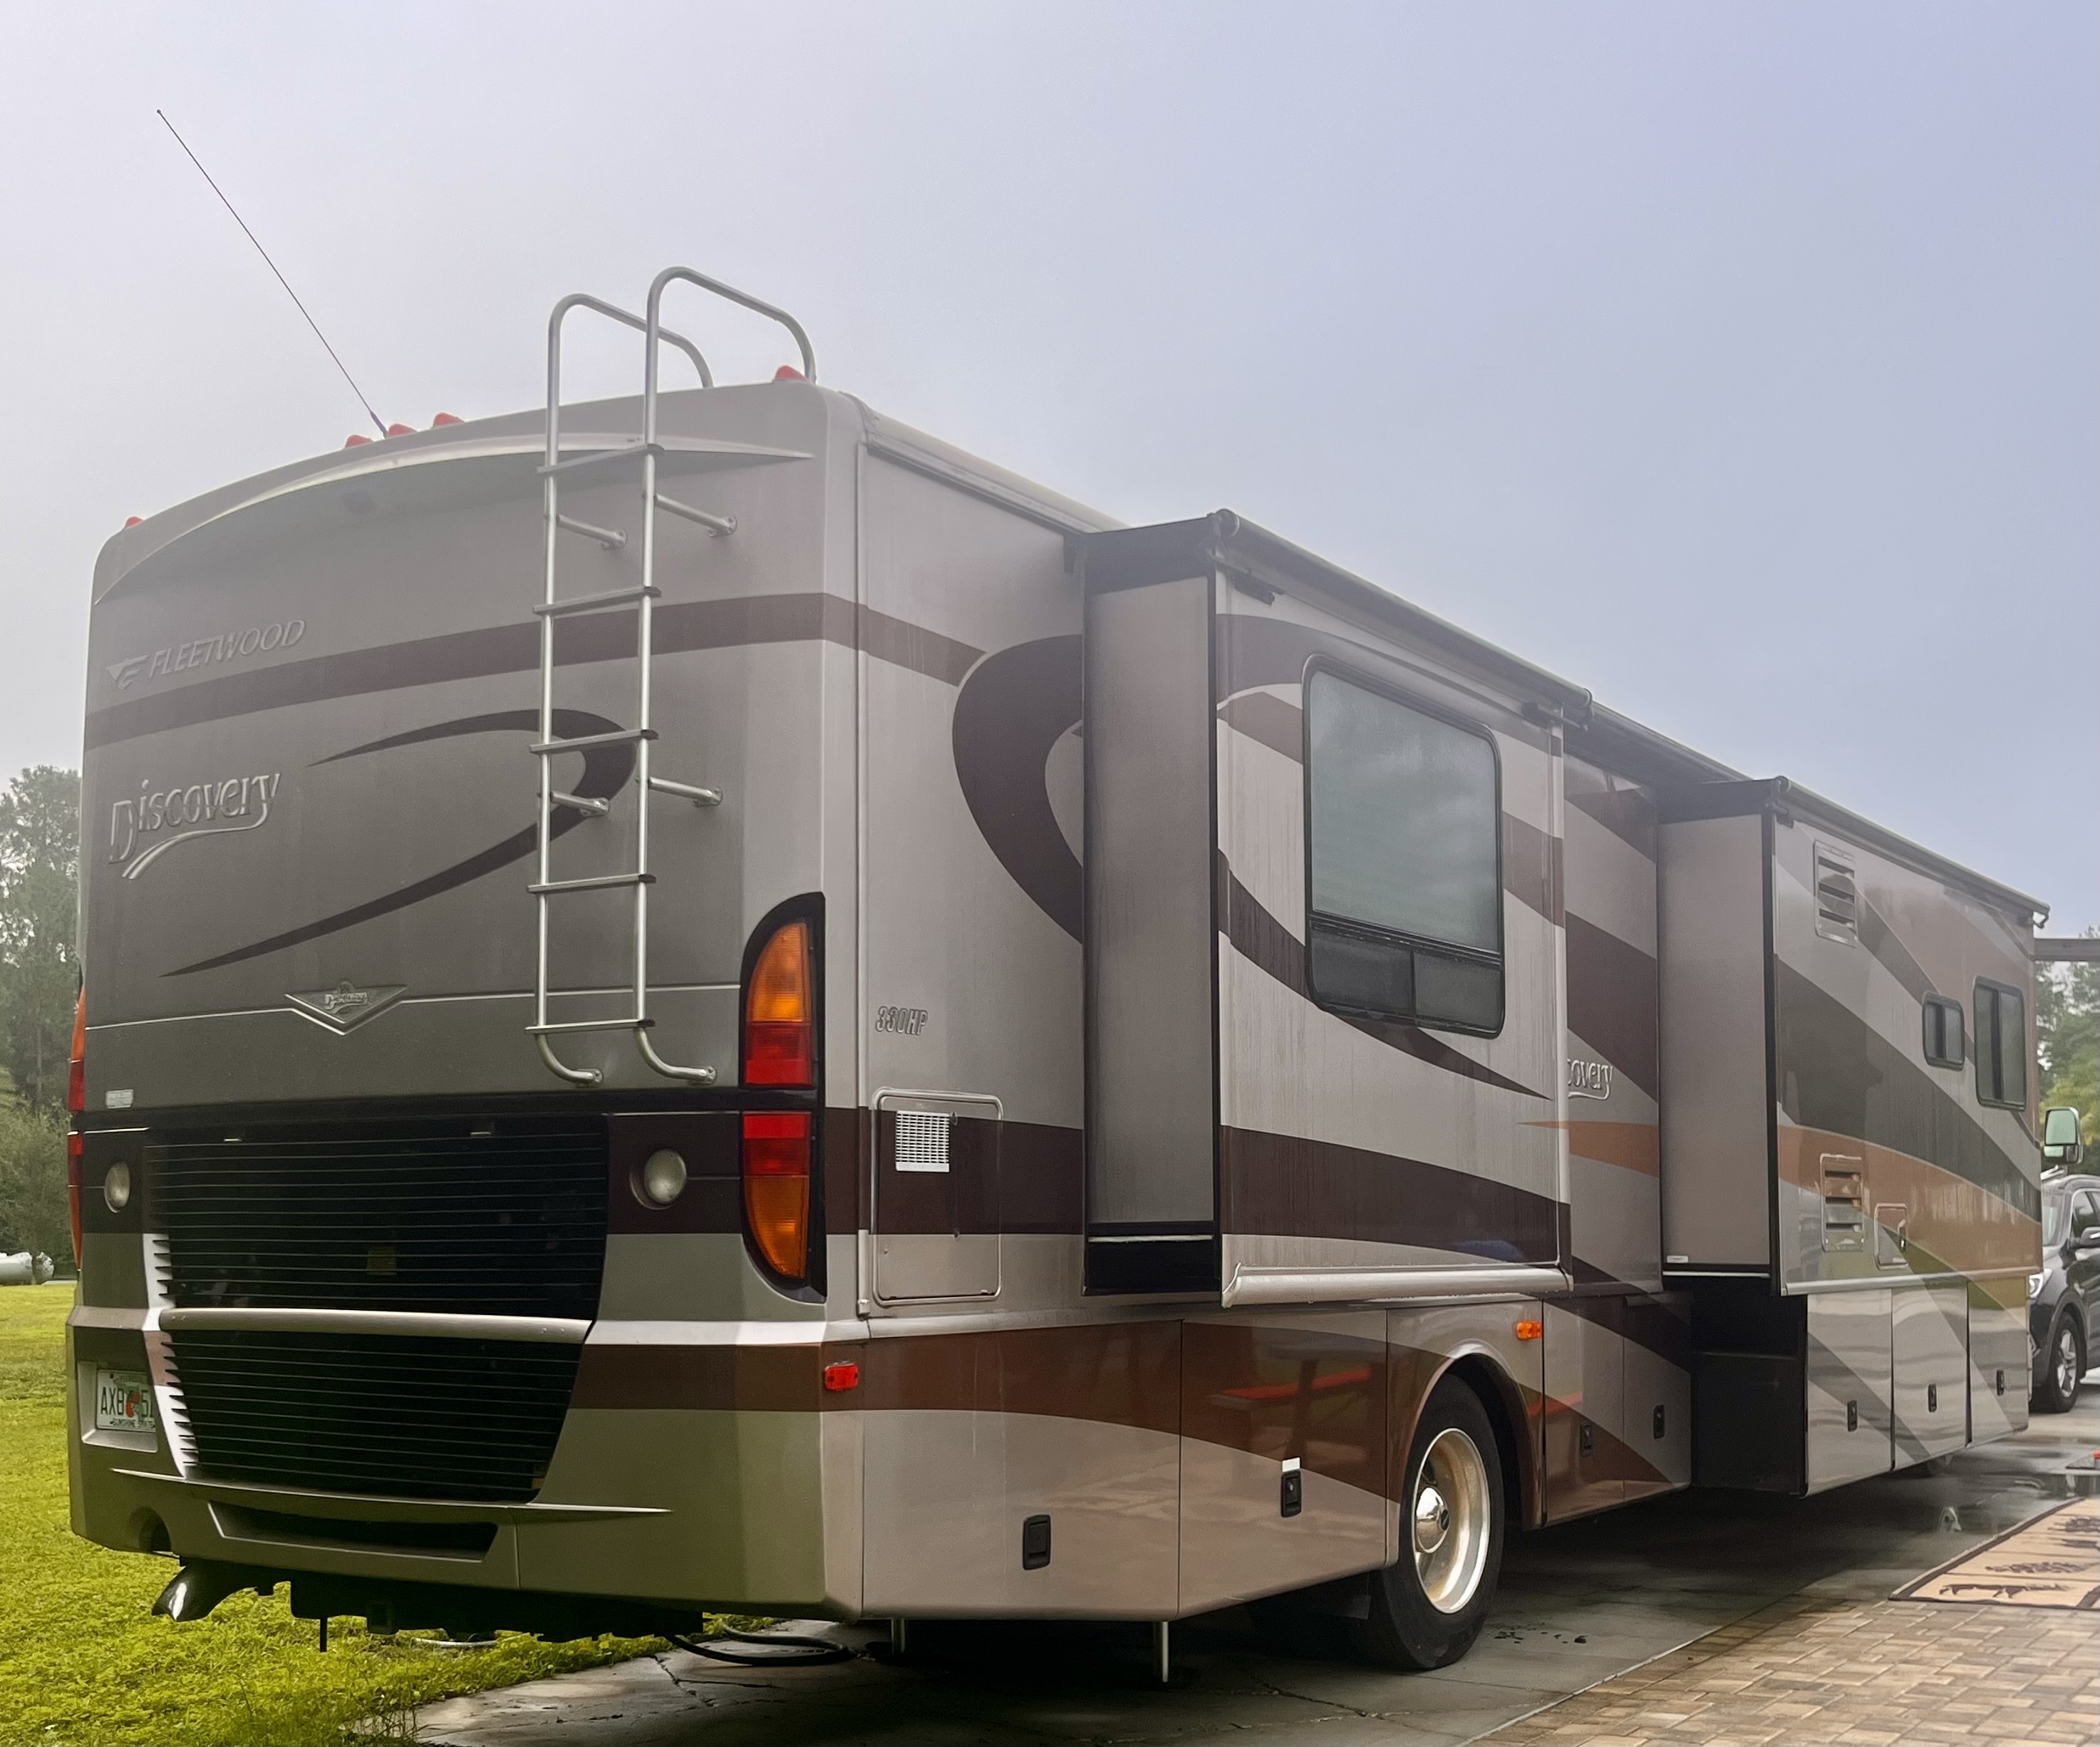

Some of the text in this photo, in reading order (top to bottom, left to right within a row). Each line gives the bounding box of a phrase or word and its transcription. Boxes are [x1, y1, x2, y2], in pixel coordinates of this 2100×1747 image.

[148, 619, 306, 679] FLEETWOOD
[108, 773, 280, 880] Discovery
[875, 1006, 929, 1036] 330HP
